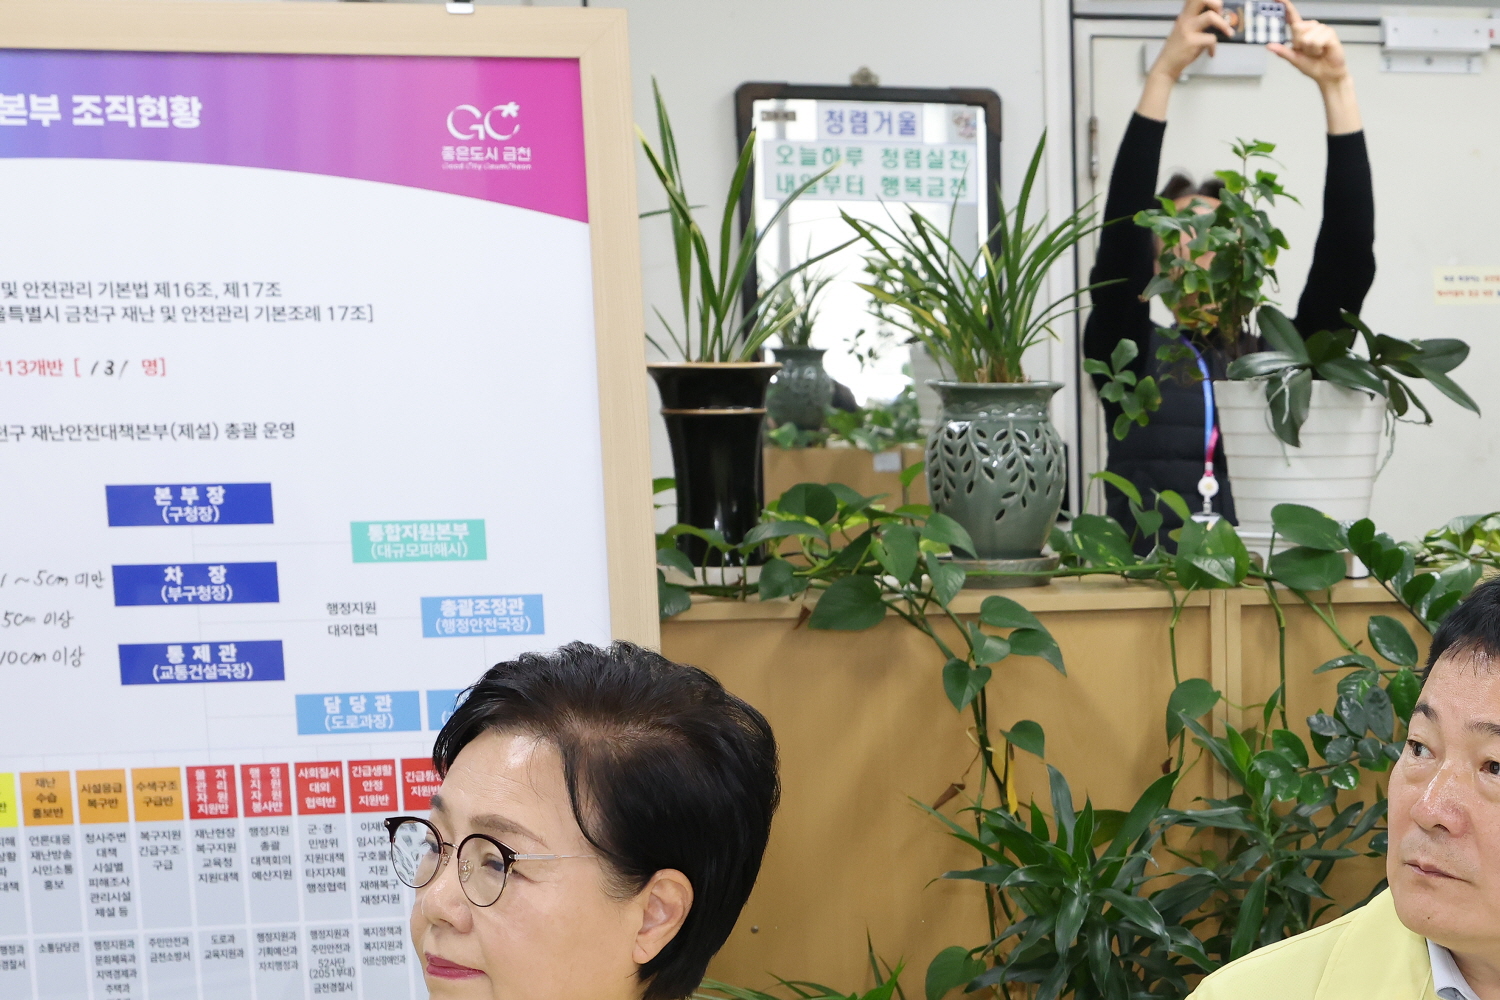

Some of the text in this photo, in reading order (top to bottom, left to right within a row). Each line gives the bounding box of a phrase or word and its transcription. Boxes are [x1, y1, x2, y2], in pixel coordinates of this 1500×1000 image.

[71, 94, 203, 129] 조직현황
[824, 109, 917, 136] 청렴거울
[441, 145, 532, 162] 좋은도시 금천
[776, 145, 968, 171] 오늘하루 청렴실천
[880, 175, 969, 199] 행복금천
[1, 280, 283, 300] 및 안전관리 기본법 제16조, 제17조
[64, 304, 117, 324] 금천구
[121, 304, 156, 324] 재난
[160, 304, 178, 324] 및
[181, 304, 250, 324] 안전관리
[254, 304, 322, 323] 기본조례
[327, 303, 375, 324] 17조]
[31, 421, 296, 444] 재난안전대책본부(제설) 총괄 운영
[161, 504, 221, 525] (구청장)
[366, 522, 470, 542] 통합지원본부
[370, 542, 469, 560] (대규모피해시)
[160, 584, 233, 603] (부구청장)
[325, 601, 377, 616] 행정지원
[439, 596, 525, 617] 총괄조정관
[43, 609, 75, 629] 이상
[434, 616, 532, 636] (행정안전국장)
[327, 623, 379, 638] 대외협력
[52, 644, 86, 668] 이상
[152, 662, 254, 682] (교통건설국장)
[323, 713, 394, 732] (도로과장)
[297, 766, 340, 780] 사회질서
[351, 764, 393, 778] 긴급생활
[308, 781, 331, 794] 대외
[362, 779, 383, 792] 안정
[358, 793, 390, 807] 지원반
[194, 827, 236, 839] 재난현장
[249, 825, 290, 837] 행정지원
[96, 847, 118, 858] 대책
[250, 854, 292, 866] 대책회의
[303, 851, 345, 864] 지원대책
[152, 859, 174, 871] 구급
[304, 866, 346, 879] 타지자체
[368, 865, 389, 876] 지원
[88, 876, 131, 888] 피해조사
[197, 871, 239, 884] 지원대책
[251, 869, 293, 882] 예산지원
[305, 881, 347, 894] 행정협력
[359, 879, 400, 891] 재해복구
[359, 894, 401, 905] 재정지원
